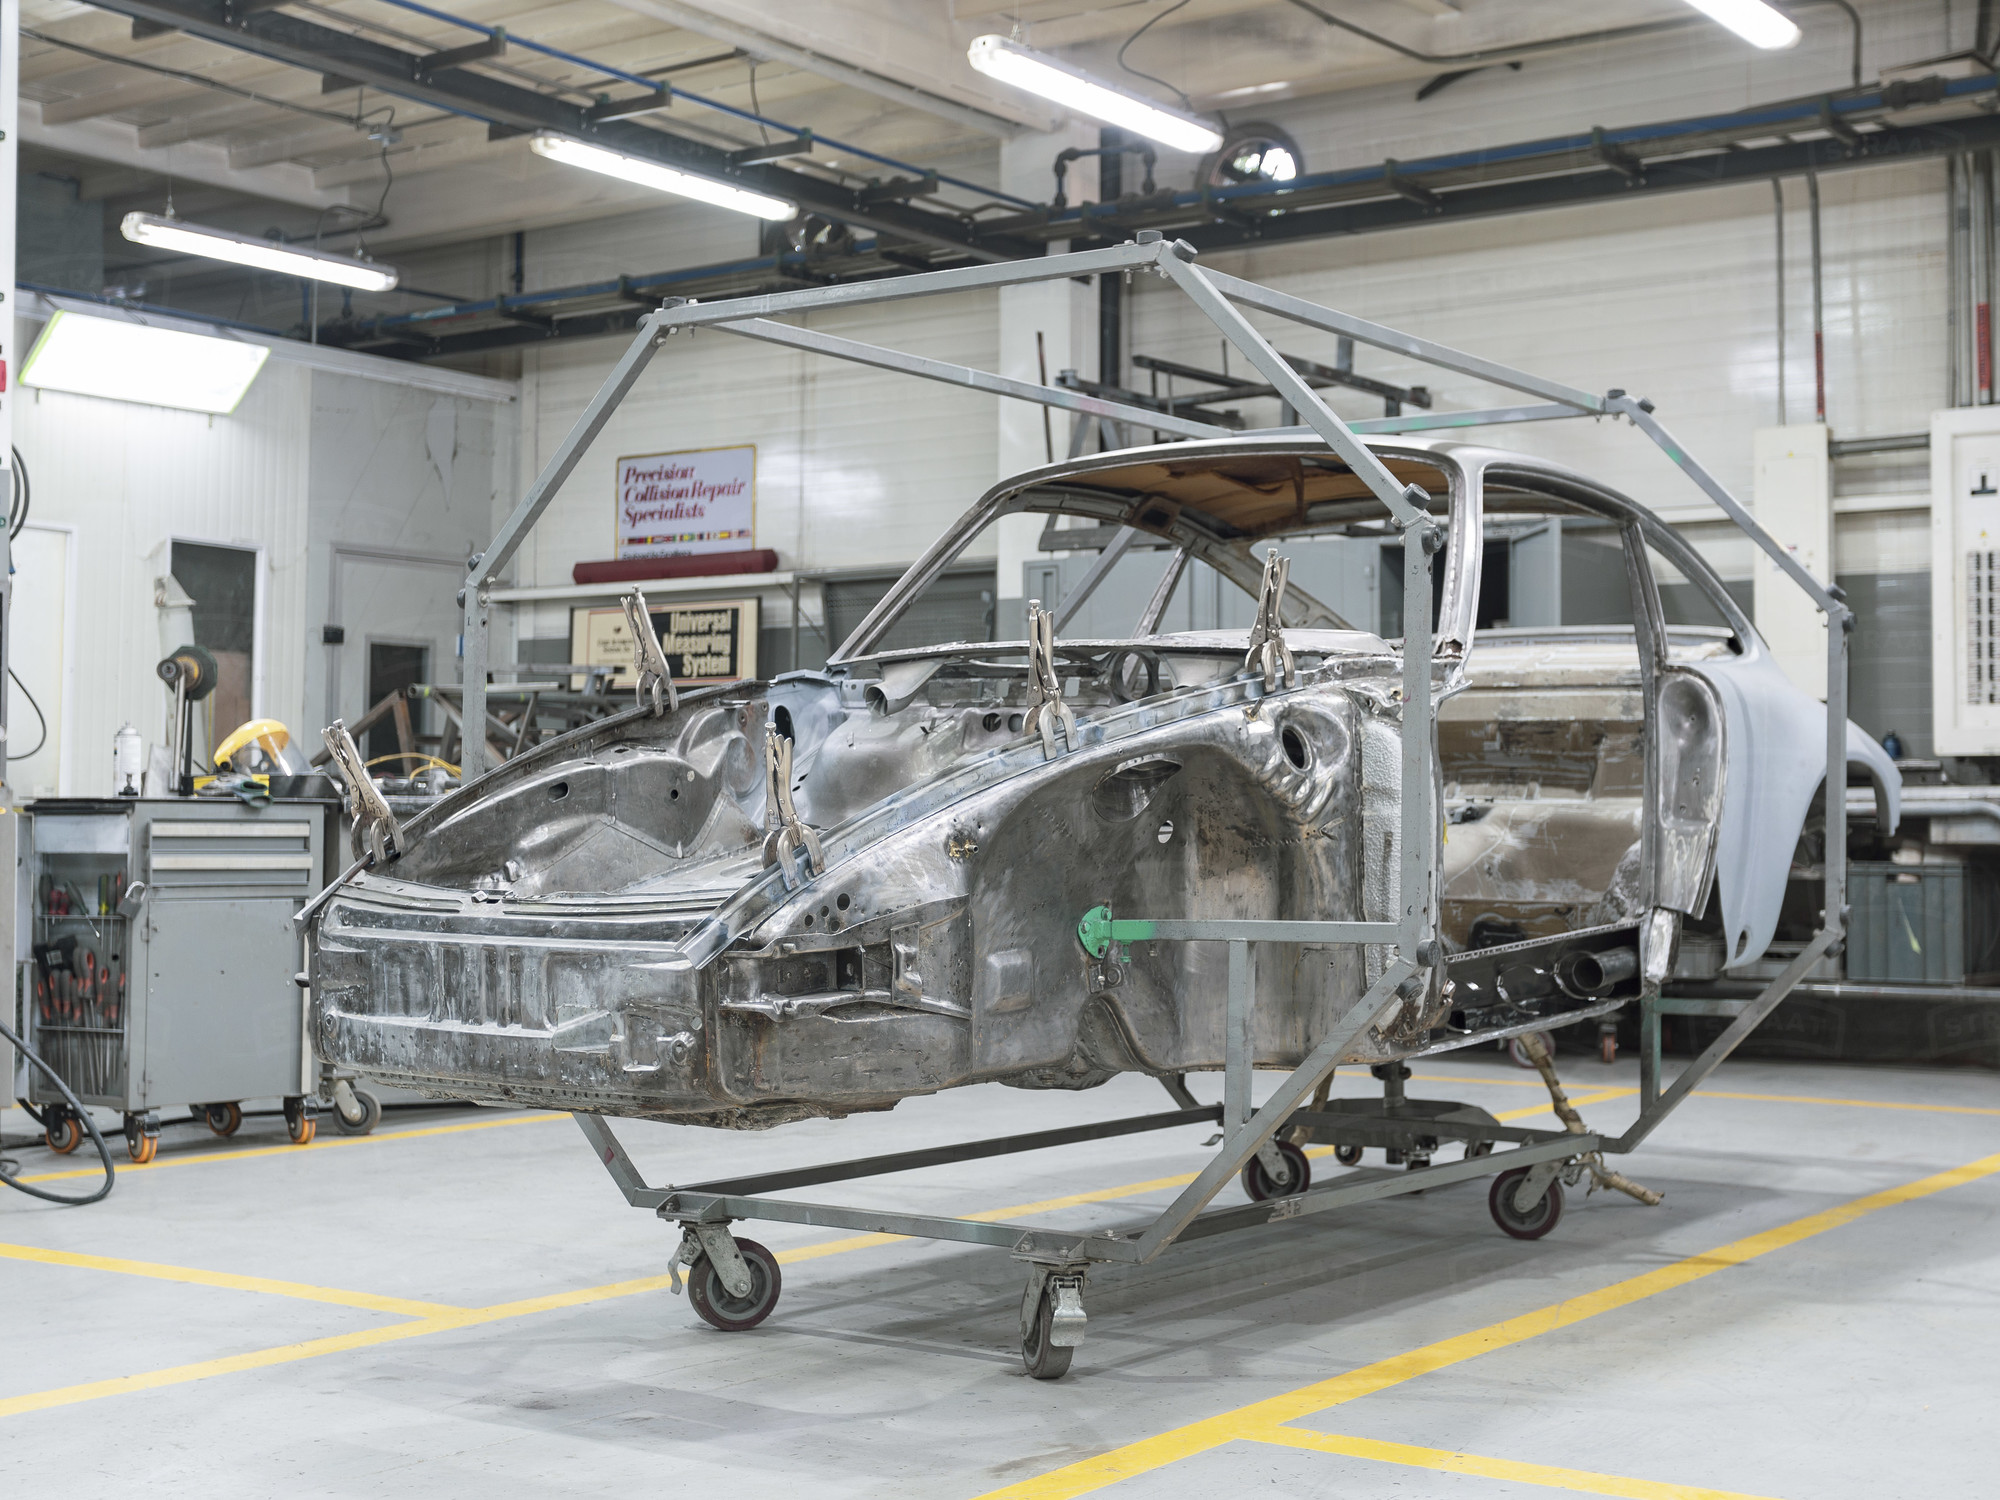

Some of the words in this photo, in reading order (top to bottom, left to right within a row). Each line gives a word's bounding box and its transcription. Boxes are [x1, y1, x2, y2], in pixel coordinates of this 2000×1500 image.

[624, 463, 695, 485] Precision
[624, 483, 689, 503] Collision
[691, 477, 746, 503] Repair
[623, 501, 705, 528] Specialists
[670, 608, 732, 633] Universal
[662, 631, 731, 657] Measuring
[682, 653, 731, 679] System
